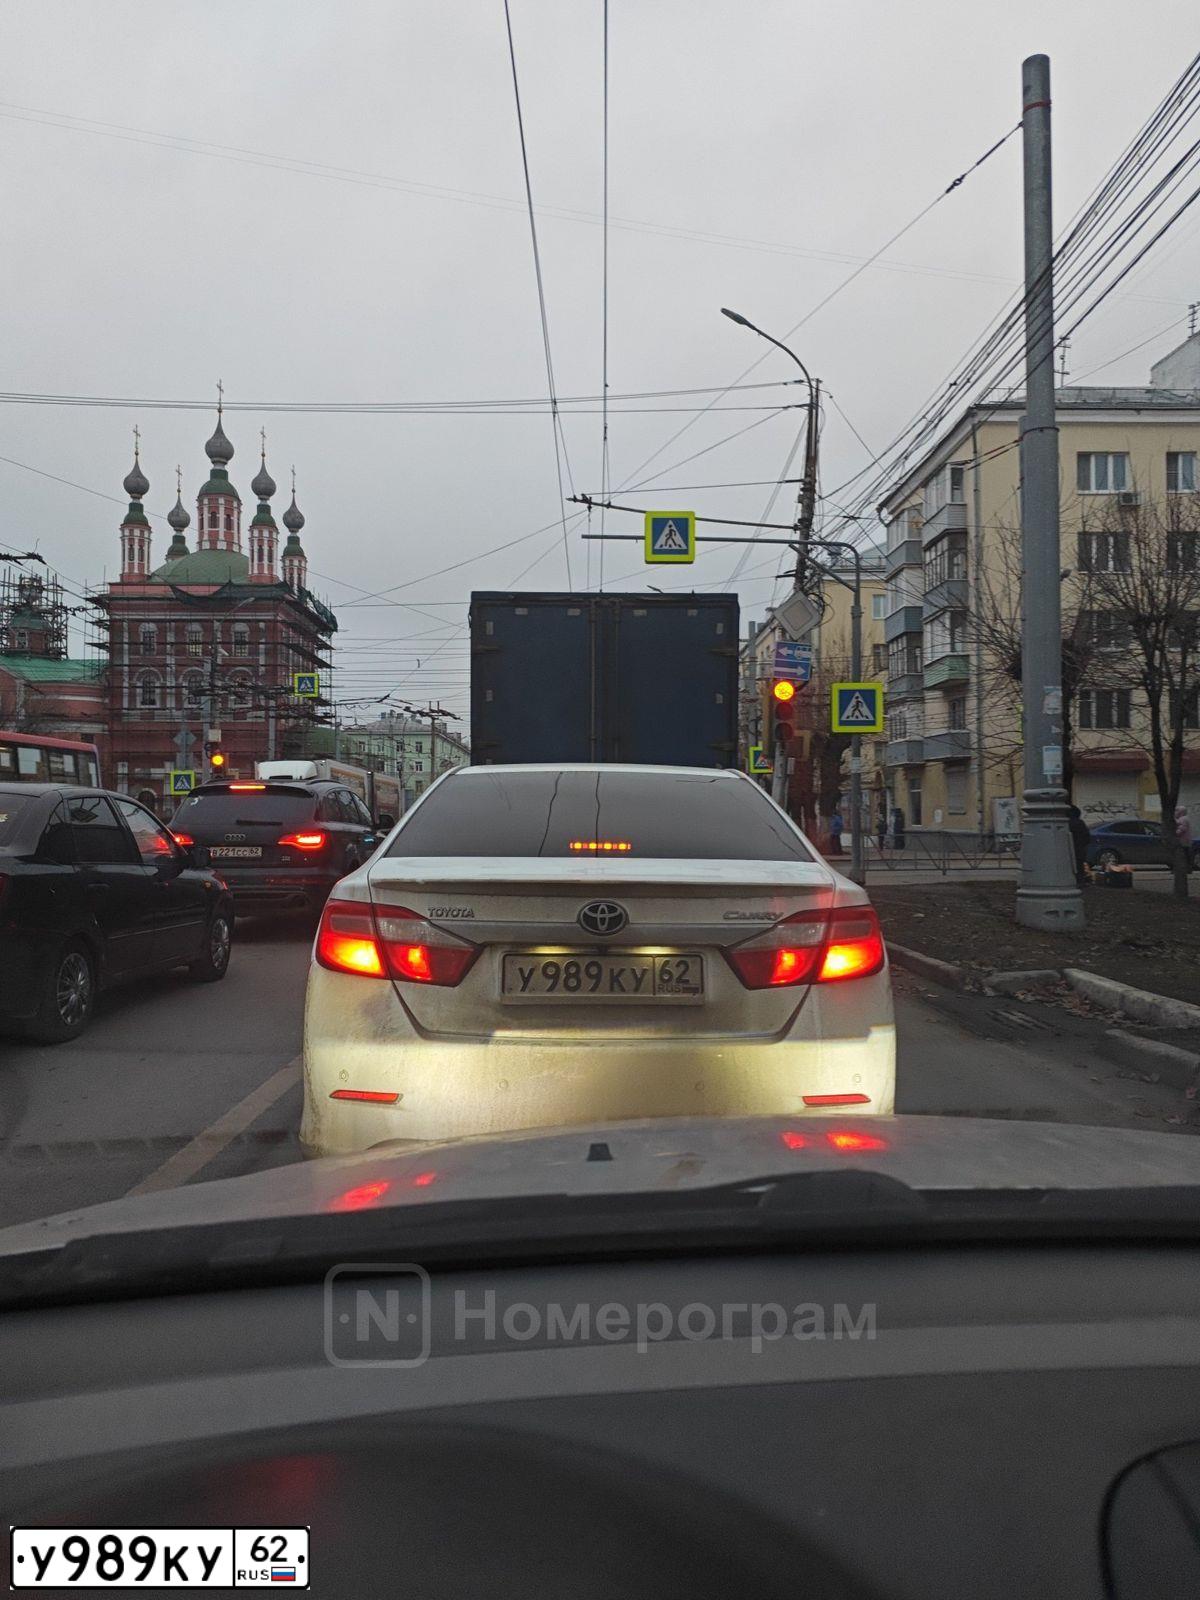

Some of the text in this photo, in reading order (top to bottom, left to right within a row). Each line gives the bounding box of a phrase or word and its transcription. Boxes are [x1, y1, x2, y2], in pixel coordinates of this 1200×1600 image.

[428, 905, 475, 919] TOYOTA
[517, 960, 690, 992] У989КУ 62
[657, 984, 681, 993] RUS
